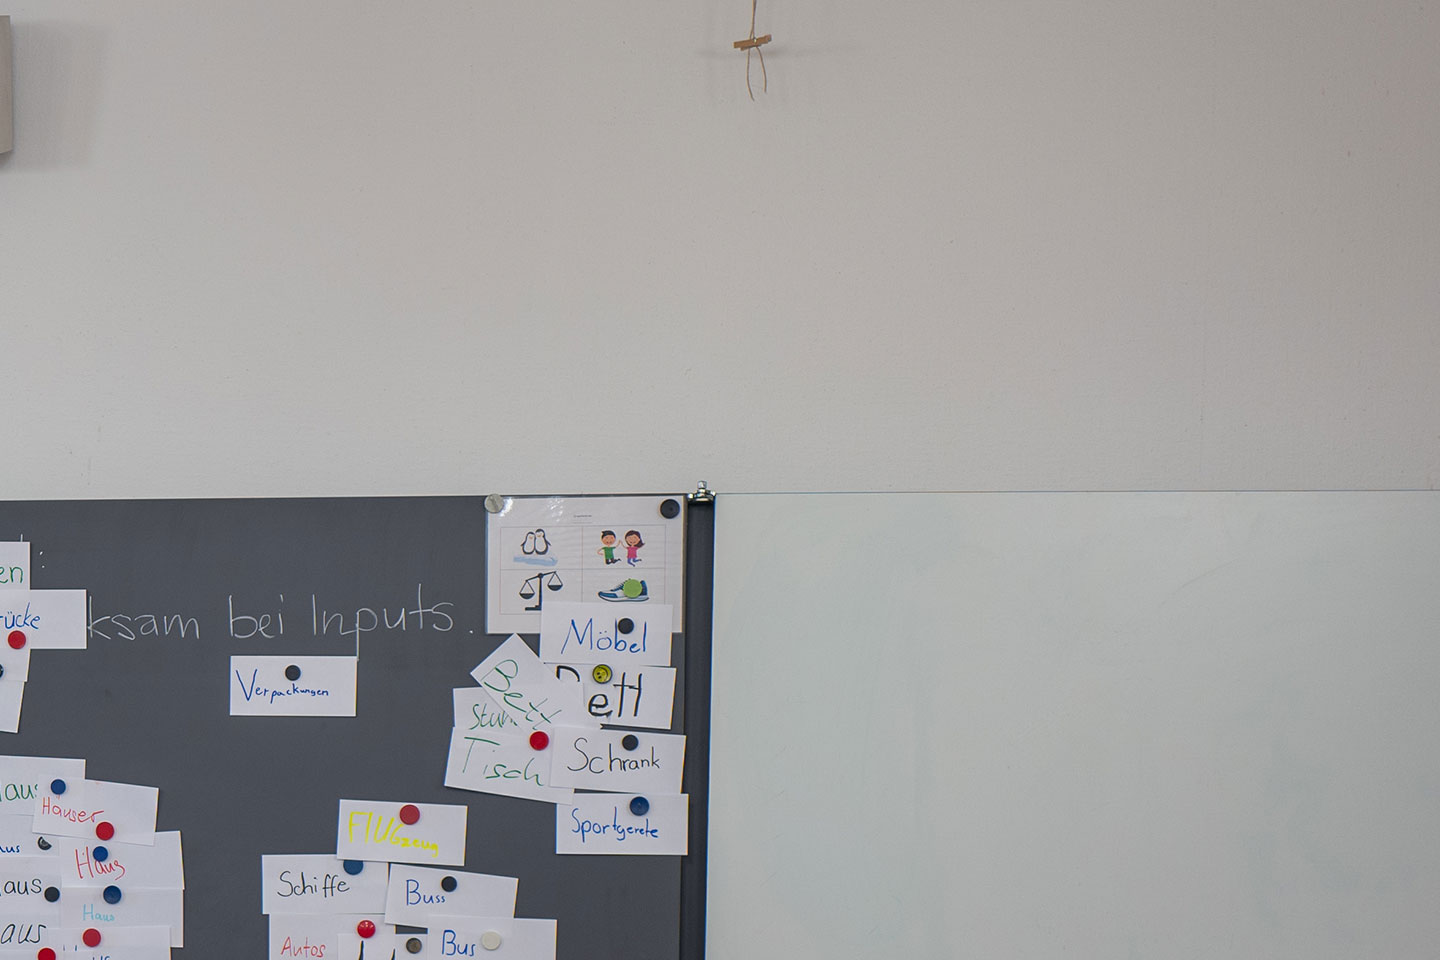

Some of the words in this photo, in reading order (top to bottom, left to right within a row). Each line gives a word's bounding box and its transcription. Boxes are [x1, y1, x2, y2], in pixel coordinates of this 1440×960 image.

[229, 594, 284, 639] bei
[561, 618, 647, 654] Möbel
[566, 737, 661, 774] Schrank
[277, 870, 350, 898] Schiffe
[406, 879, 446, 906] Buss
[82, 904, 115, 921] Haus
[280, 936, 326, 958] Autos
[441, 930, 476, 957] Bus
